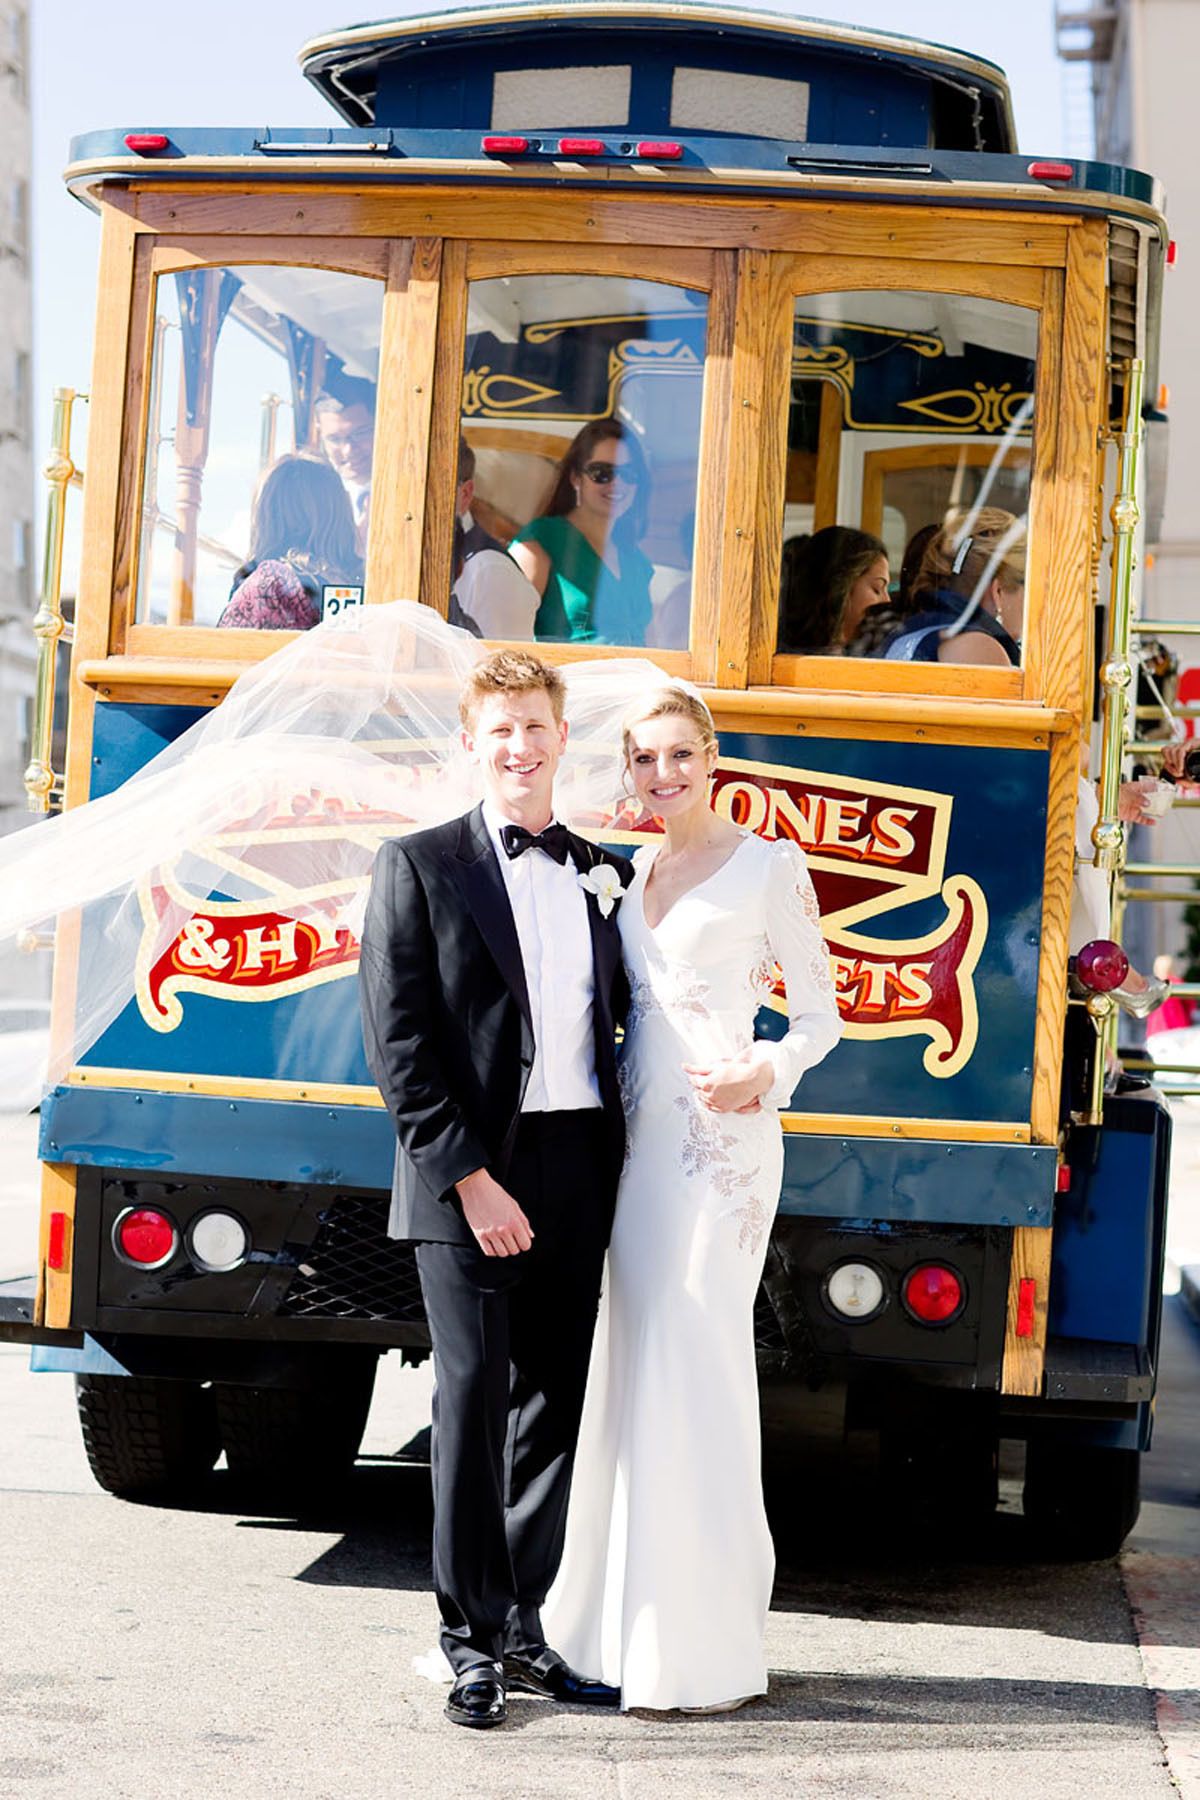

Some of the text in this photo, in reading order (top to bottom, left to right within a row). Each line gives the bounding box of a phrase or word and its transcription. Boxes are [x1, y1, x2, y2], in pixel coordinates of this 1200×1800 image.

[708, 777, 919, 861] ONES
[177, 908, 934, 1009] & HY ETS
